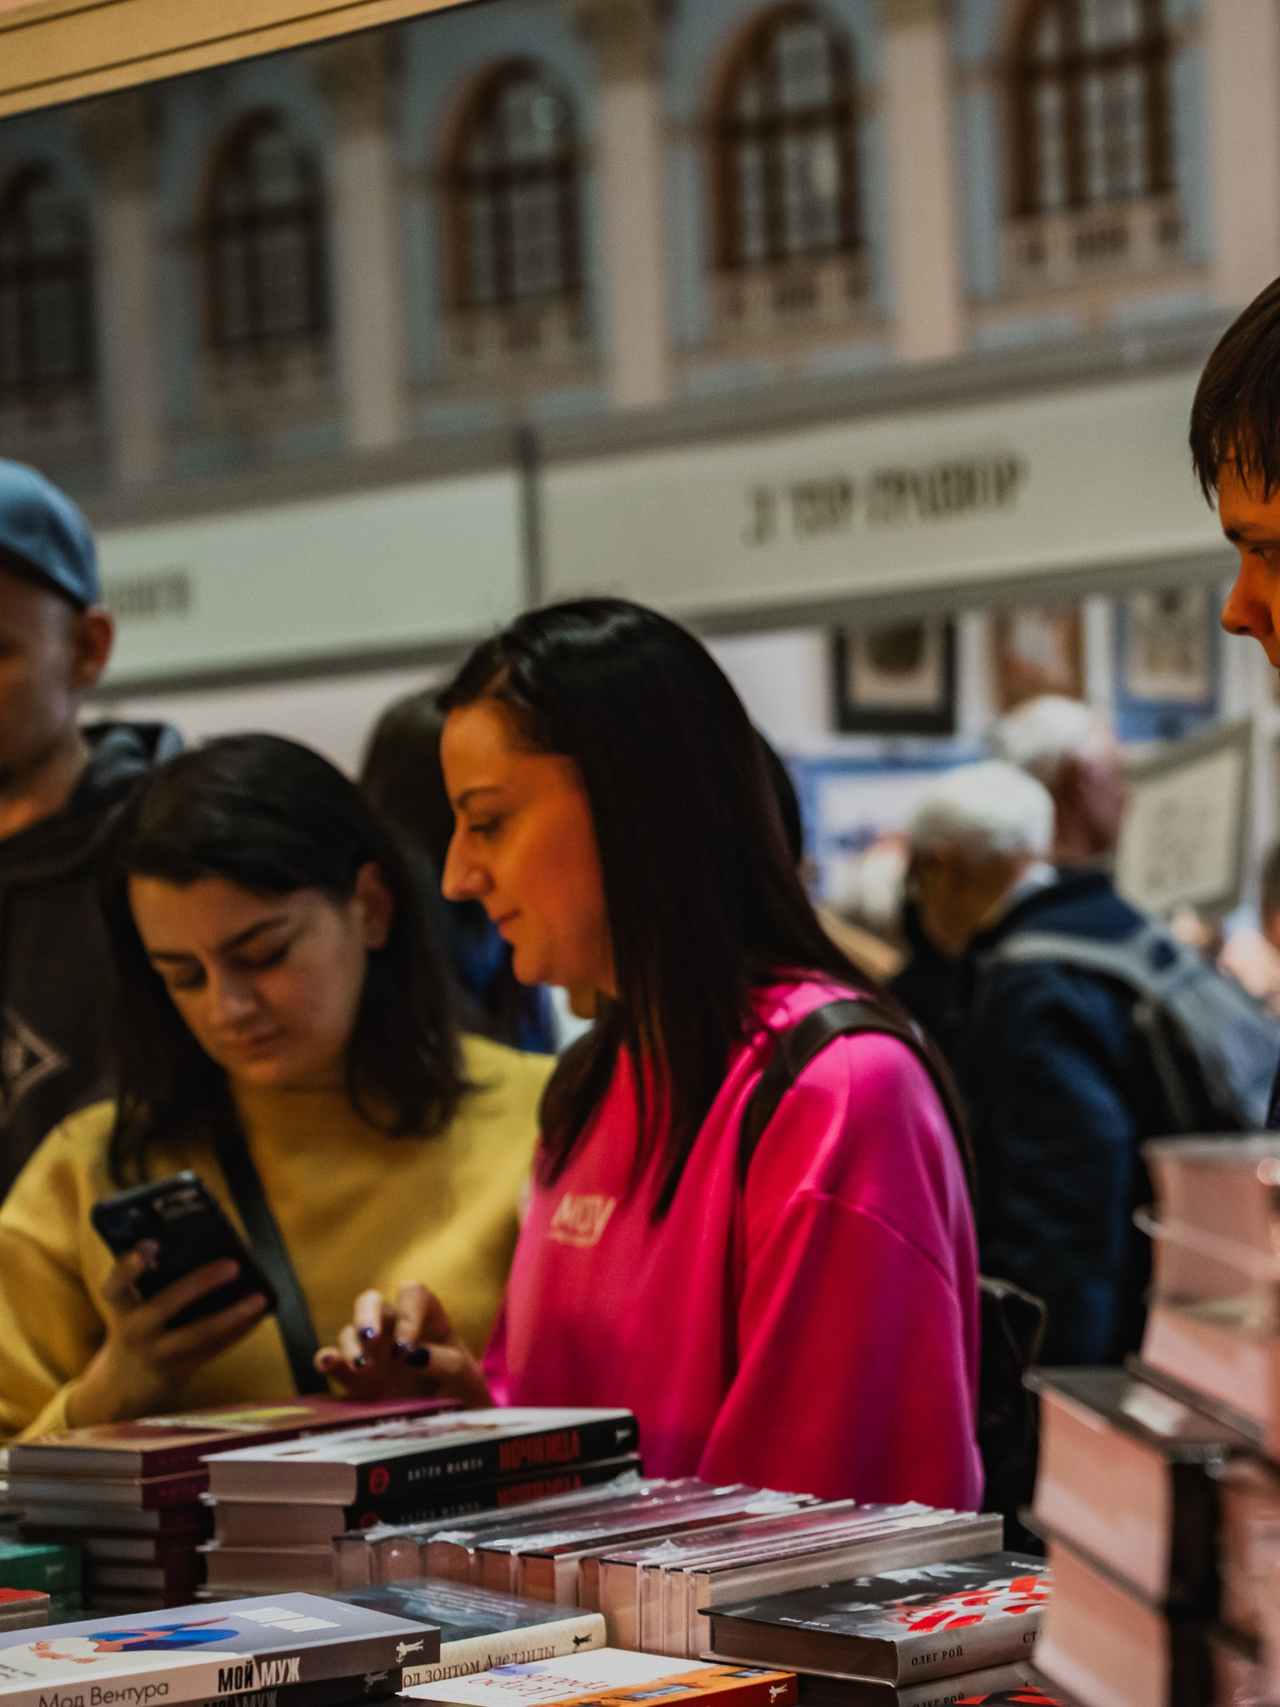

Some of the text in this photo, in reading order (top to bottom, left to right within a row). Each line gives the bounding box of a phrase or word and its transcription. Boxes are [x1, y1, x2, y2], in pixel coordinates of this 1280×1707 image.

[911, 1645, 963, 1667] ОЛЕГ РОЙ
[217, 1656, 300, 1694] МОЙ МУЖ
[39, 1683, 169, 1707] Мод Вентура
